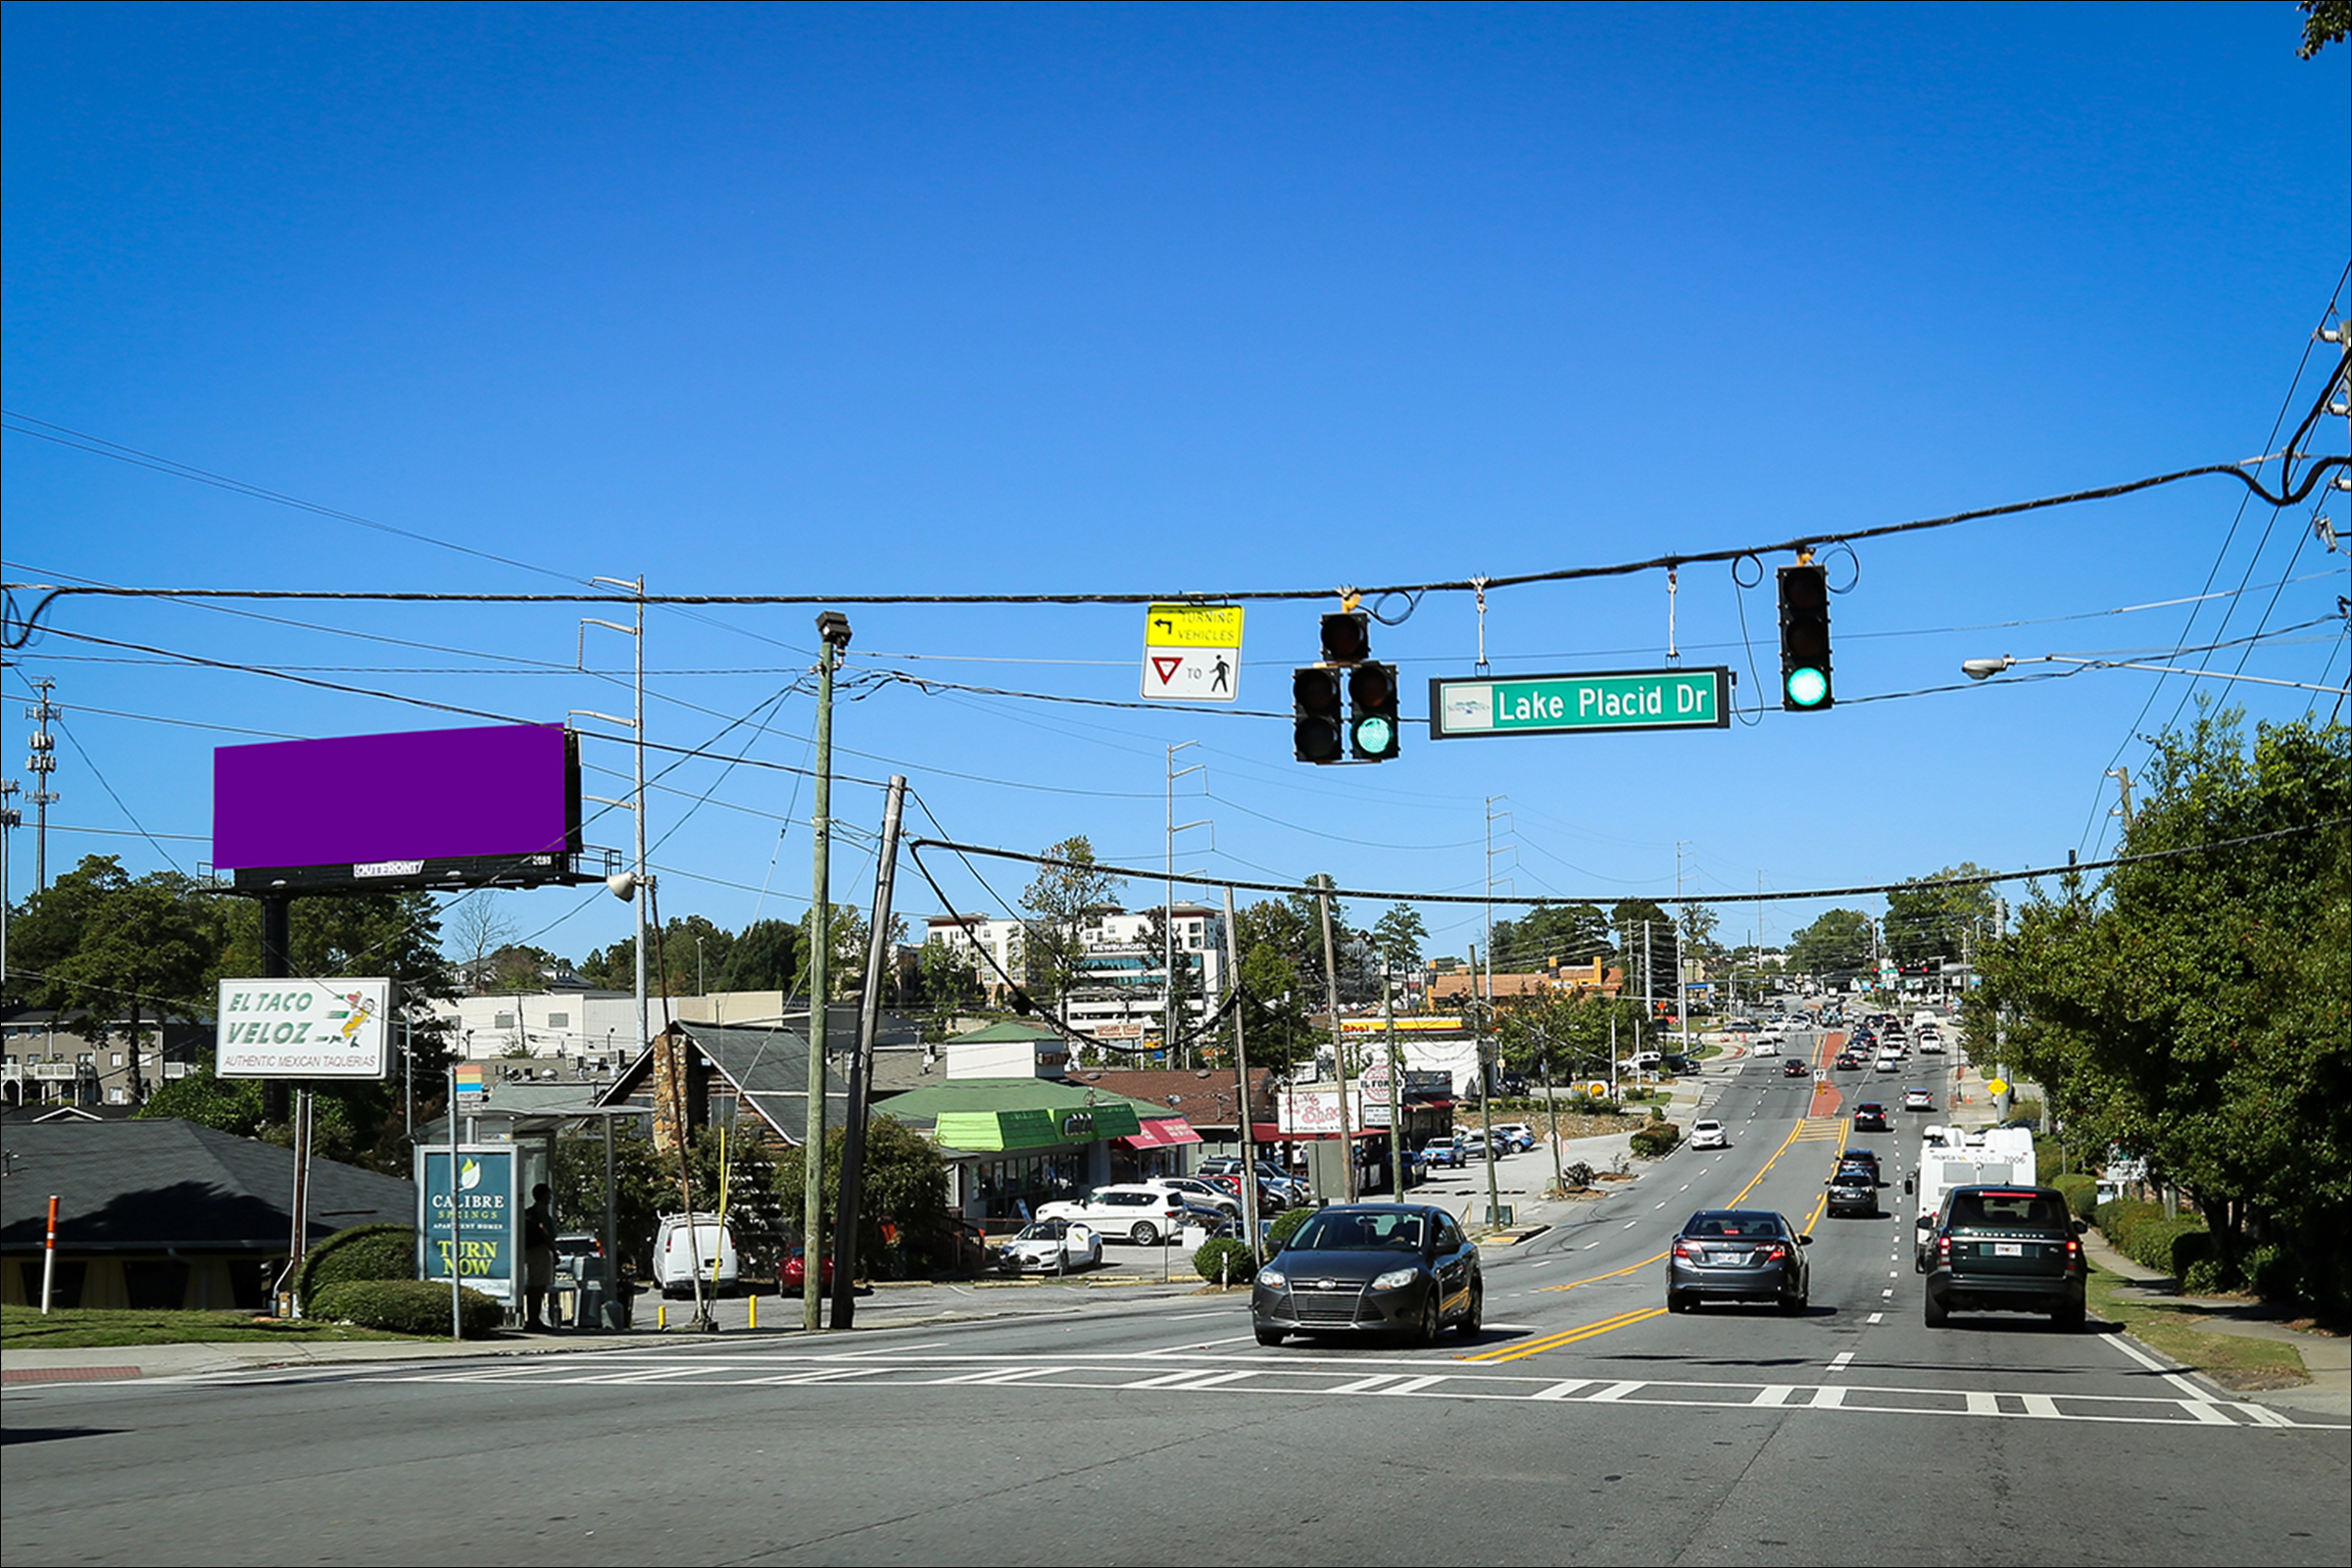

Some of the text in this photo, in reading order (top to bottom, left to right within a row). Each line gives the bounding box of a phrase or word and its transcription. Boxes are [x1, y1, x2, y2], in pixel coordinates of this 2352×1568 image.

[1182, 610, 1235, 624] TURNING
[1177, 629, 1235, 642] VEHICLES
[1187, 667, 1202, 680] TO
[1497, 689, 1565, 721] Lake
[1578, 685, 1663, 717] Placid
[1676, 683, 1708, 713] Dr
[227, 992, 314, 1012] EL TACO
[225, 1021, 314, 1045] VELOZ
[223, 1054, 376, 1067] AUTHENTIC MEXICAN TAQUERIAS
[1372, 1078, 1403, 1089] FORO
[1301, 1104, 1354, 1124] Shac
[2004, 1155, 2026, 1164] 7006
[442, 1258, 493, 1276] NOW
